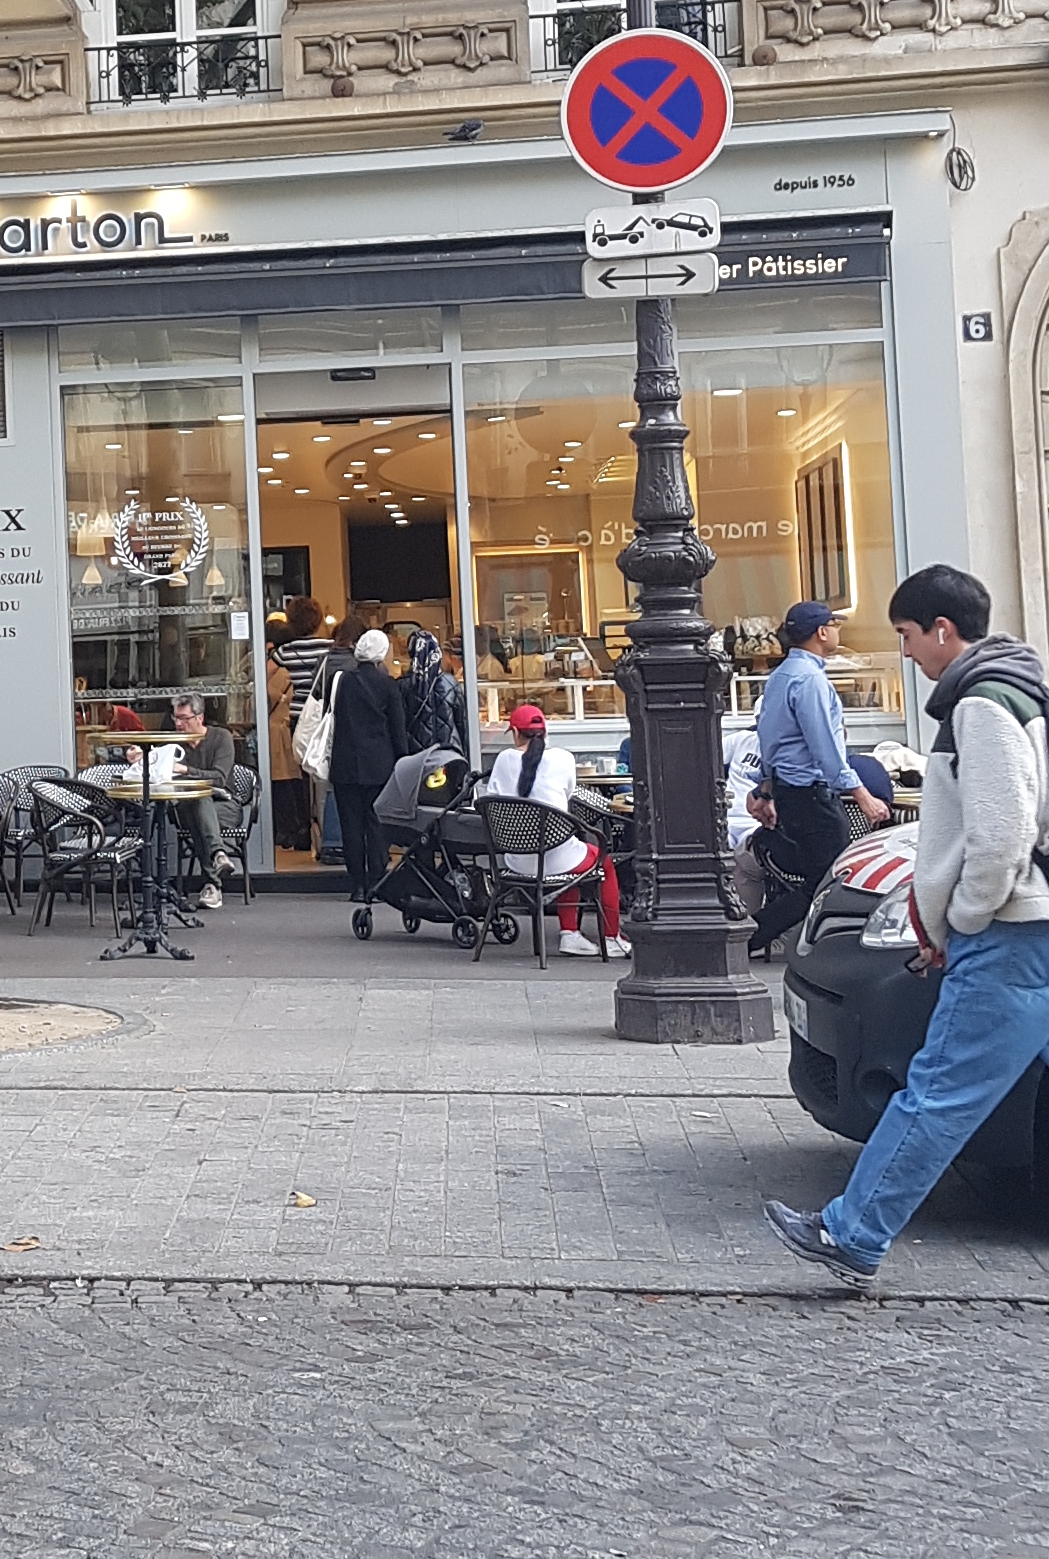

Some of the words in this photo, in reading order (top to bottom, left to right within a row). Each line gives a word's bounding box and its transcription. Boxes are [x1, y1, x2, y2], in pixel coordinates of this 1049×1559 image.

[774, 176, 818, 193] depuis
[823, 174, 855, 188] 1956
[200, 233, 229, 243] PARIS
[748, 253, 848, 278] Pâtissier
[969, 316, 985, 338] 6
[155, 511, 184, 521] PRIX
[10, 546, 32, 558] DU
[0, 600, 20, 612] DU
